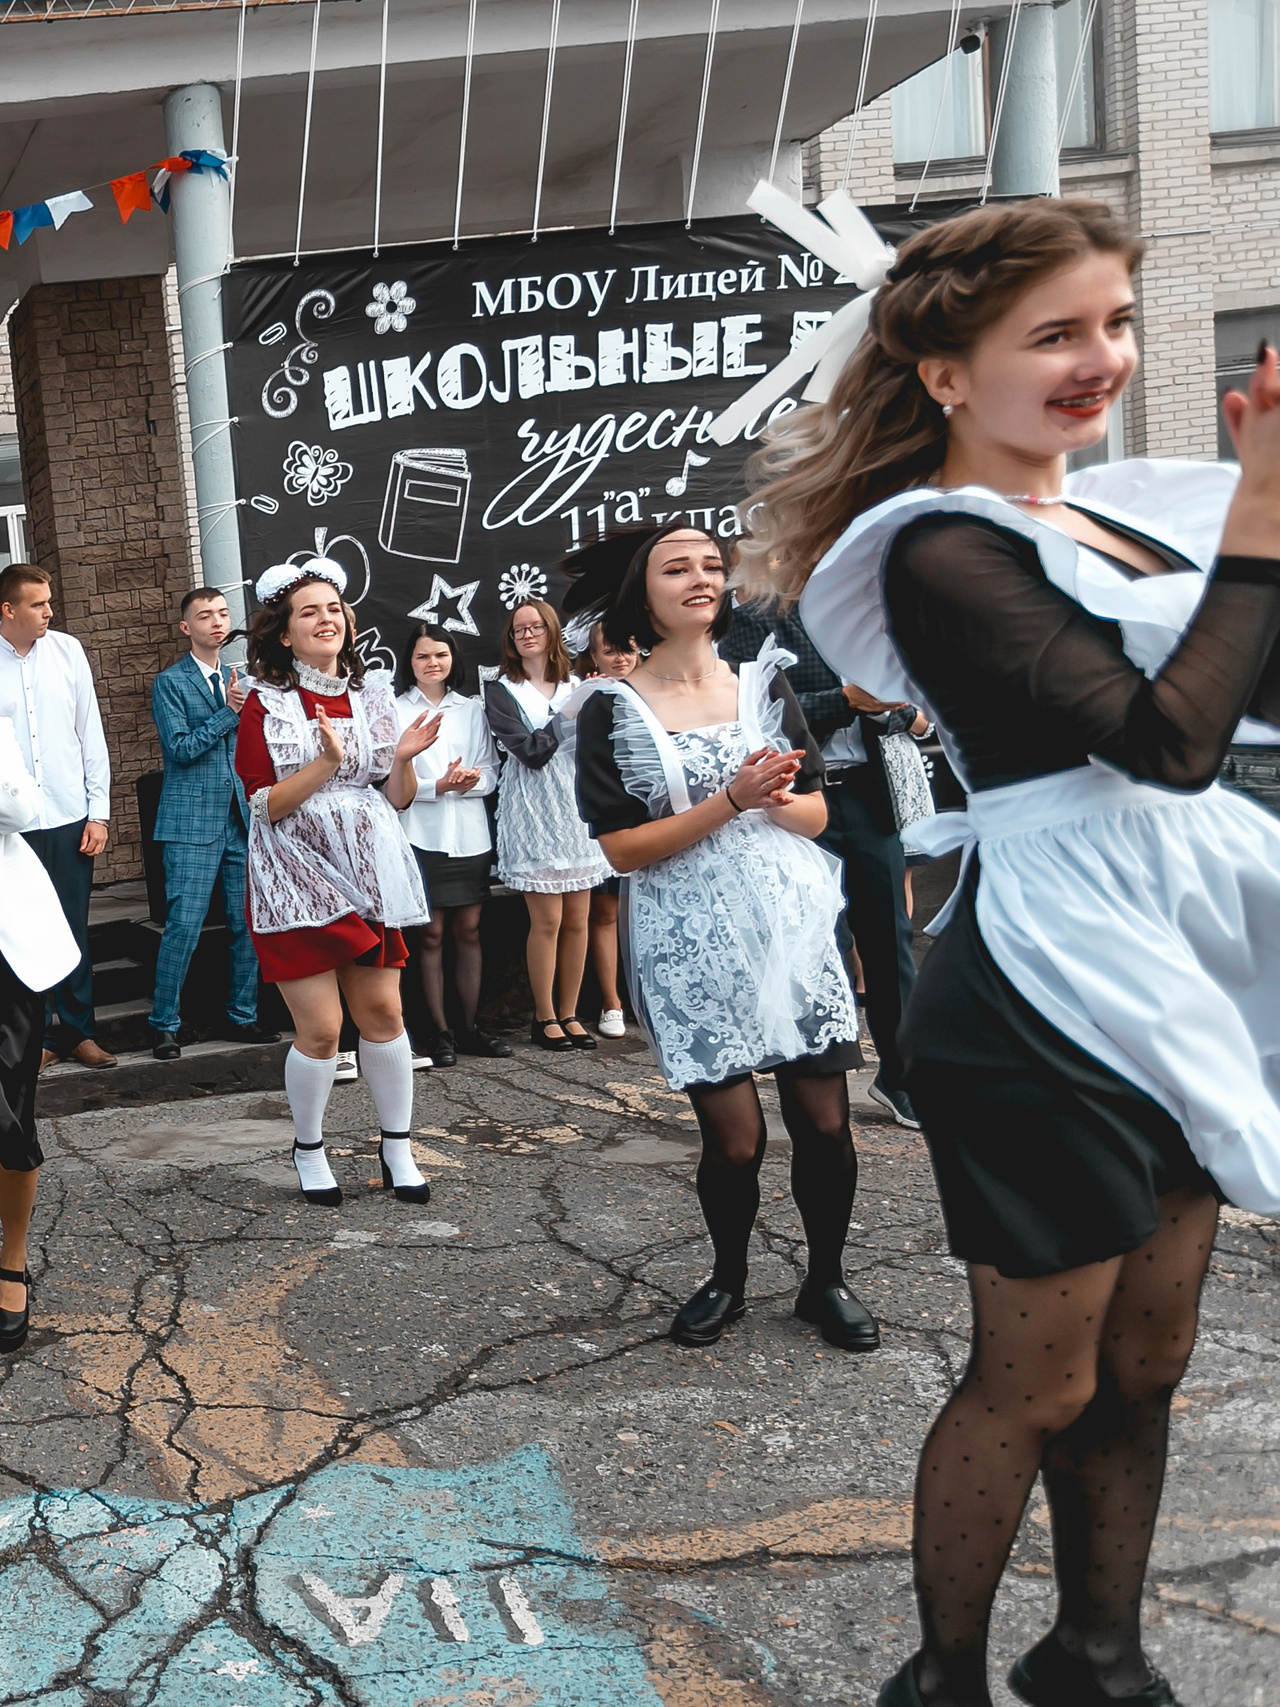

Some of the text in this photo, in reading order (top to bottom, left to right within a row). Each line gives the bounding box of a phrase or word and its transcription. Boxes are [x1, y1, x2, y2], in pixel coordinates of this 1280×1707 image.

[472, 252, 824, 318] МБОУ Лицей №
[323, 313, 768, 432] ШКОЛЬНЫЕ
